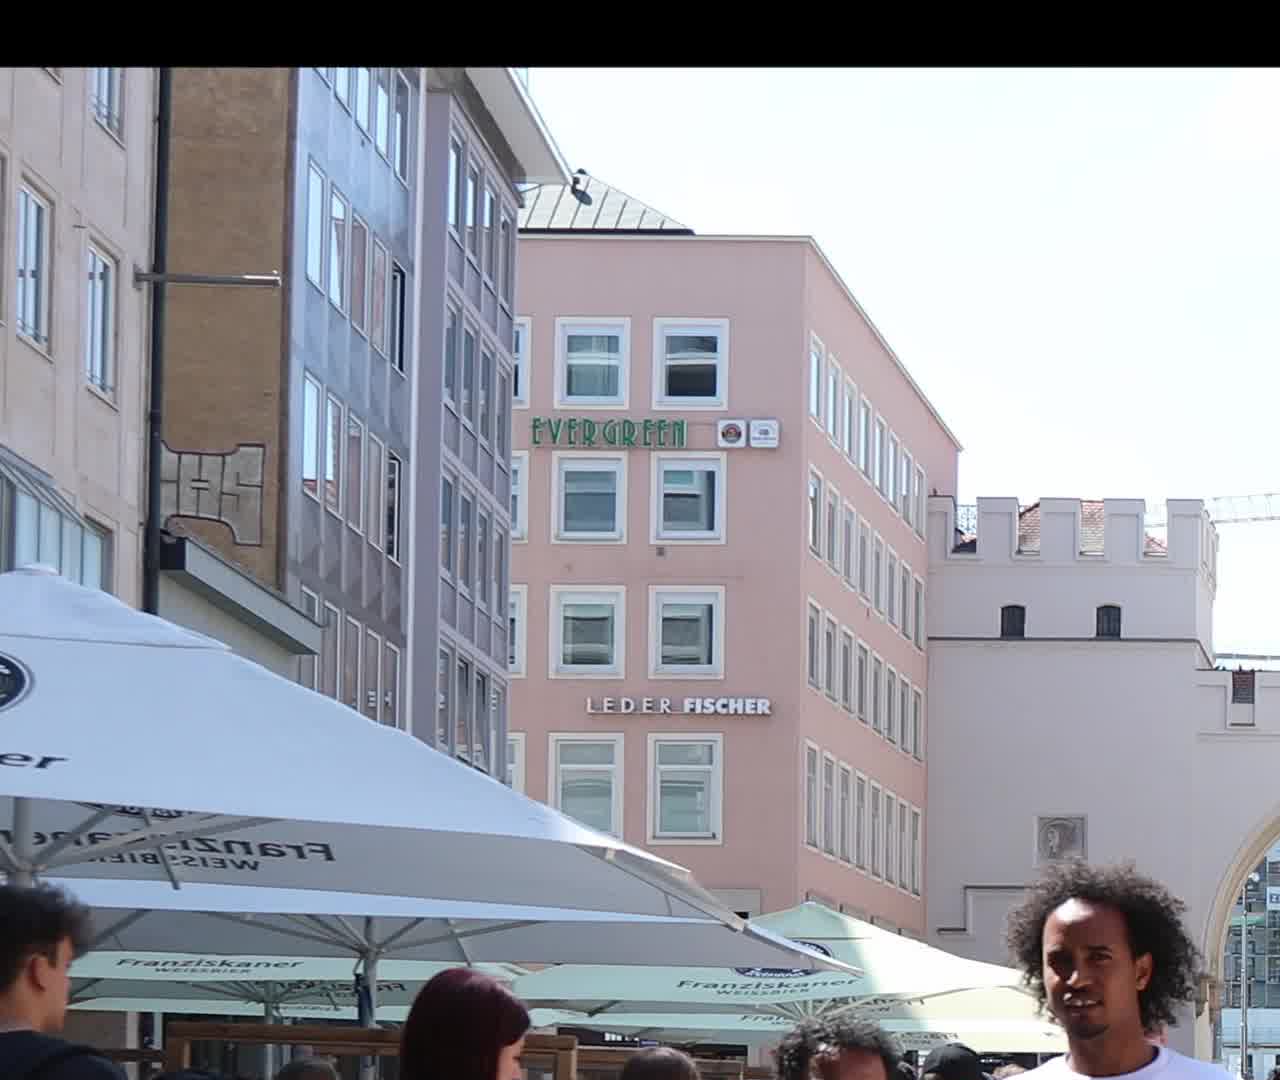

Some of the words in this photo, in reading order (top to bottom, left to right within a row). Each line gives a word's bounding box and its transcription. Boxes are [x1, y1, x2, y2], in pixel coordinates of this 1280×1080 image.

[532, 417, 688, 448] EVERGREEN
[586, 698, 672, 714] LEDER
[684, 698, 772, 715] FISCHER
